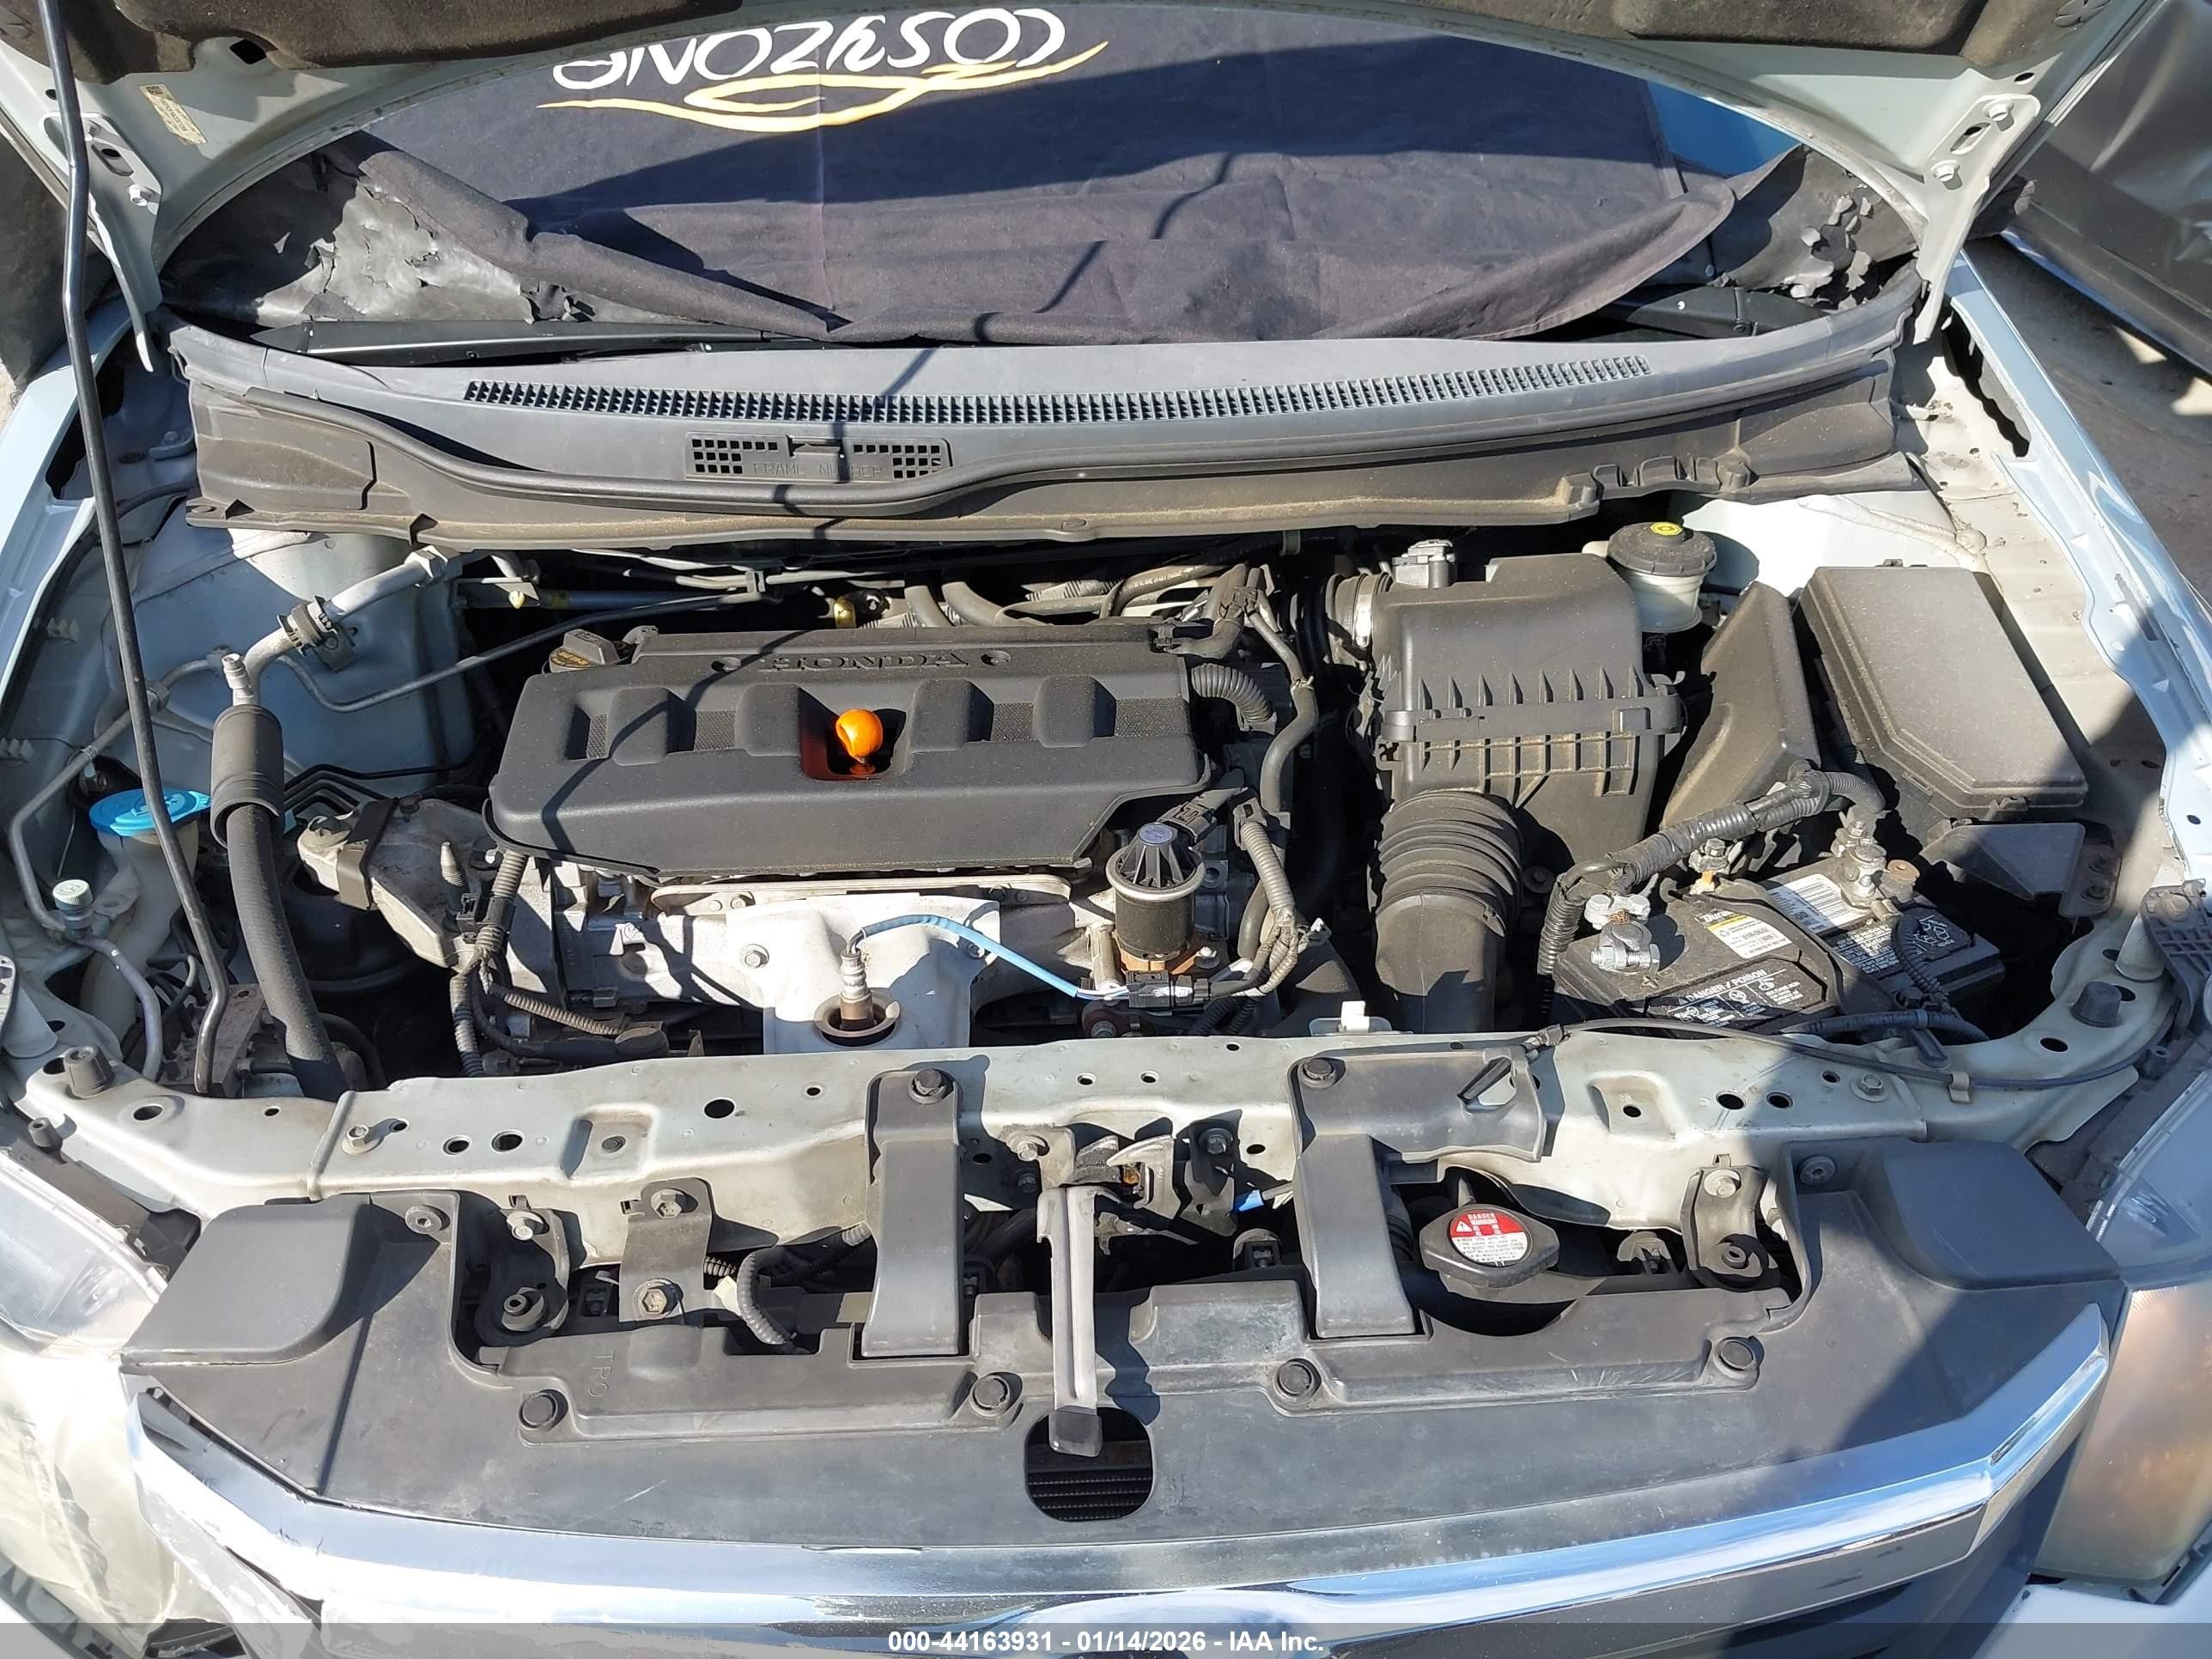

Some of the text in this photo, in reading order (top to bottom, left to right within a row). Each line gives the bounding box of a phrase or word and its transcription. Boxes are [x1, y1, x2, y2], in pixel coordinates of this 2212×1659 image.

[752, 461, 883, 478] FRAME NUMBER
[758, 652, 969, 672] HONDA
[1686, 984, 1726, 1002] DANGER
[1730, 969, 1767, 987] POISON
